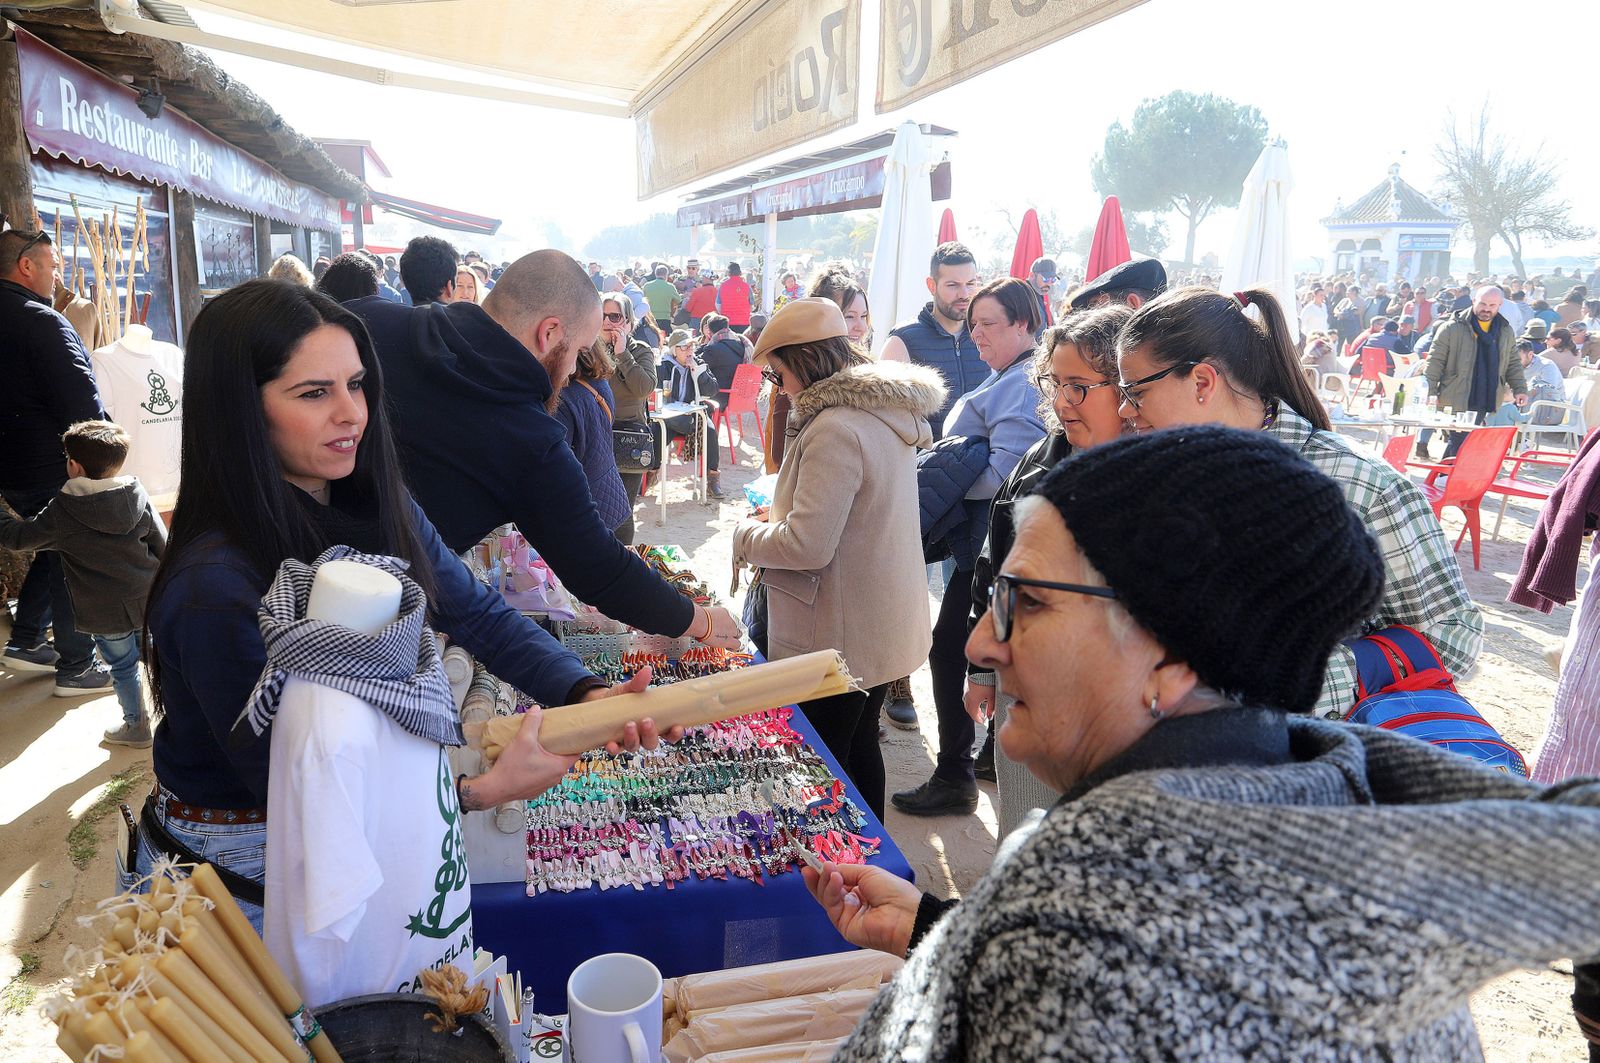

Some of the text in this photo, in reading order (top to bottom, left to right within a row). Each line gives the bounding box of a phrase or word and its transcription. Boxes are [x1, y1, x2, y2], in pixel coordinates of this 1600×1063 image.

[59, 76, 179, 169] Restaurante
[190, 138, 213, 181] Bar
[233, 161, 252, 196] LAS
[830, 174, 865, 196] Cruzcampo
[141, 417, 173, 425] CANDELARIA
[396, 927, 474, 994] CADELA
